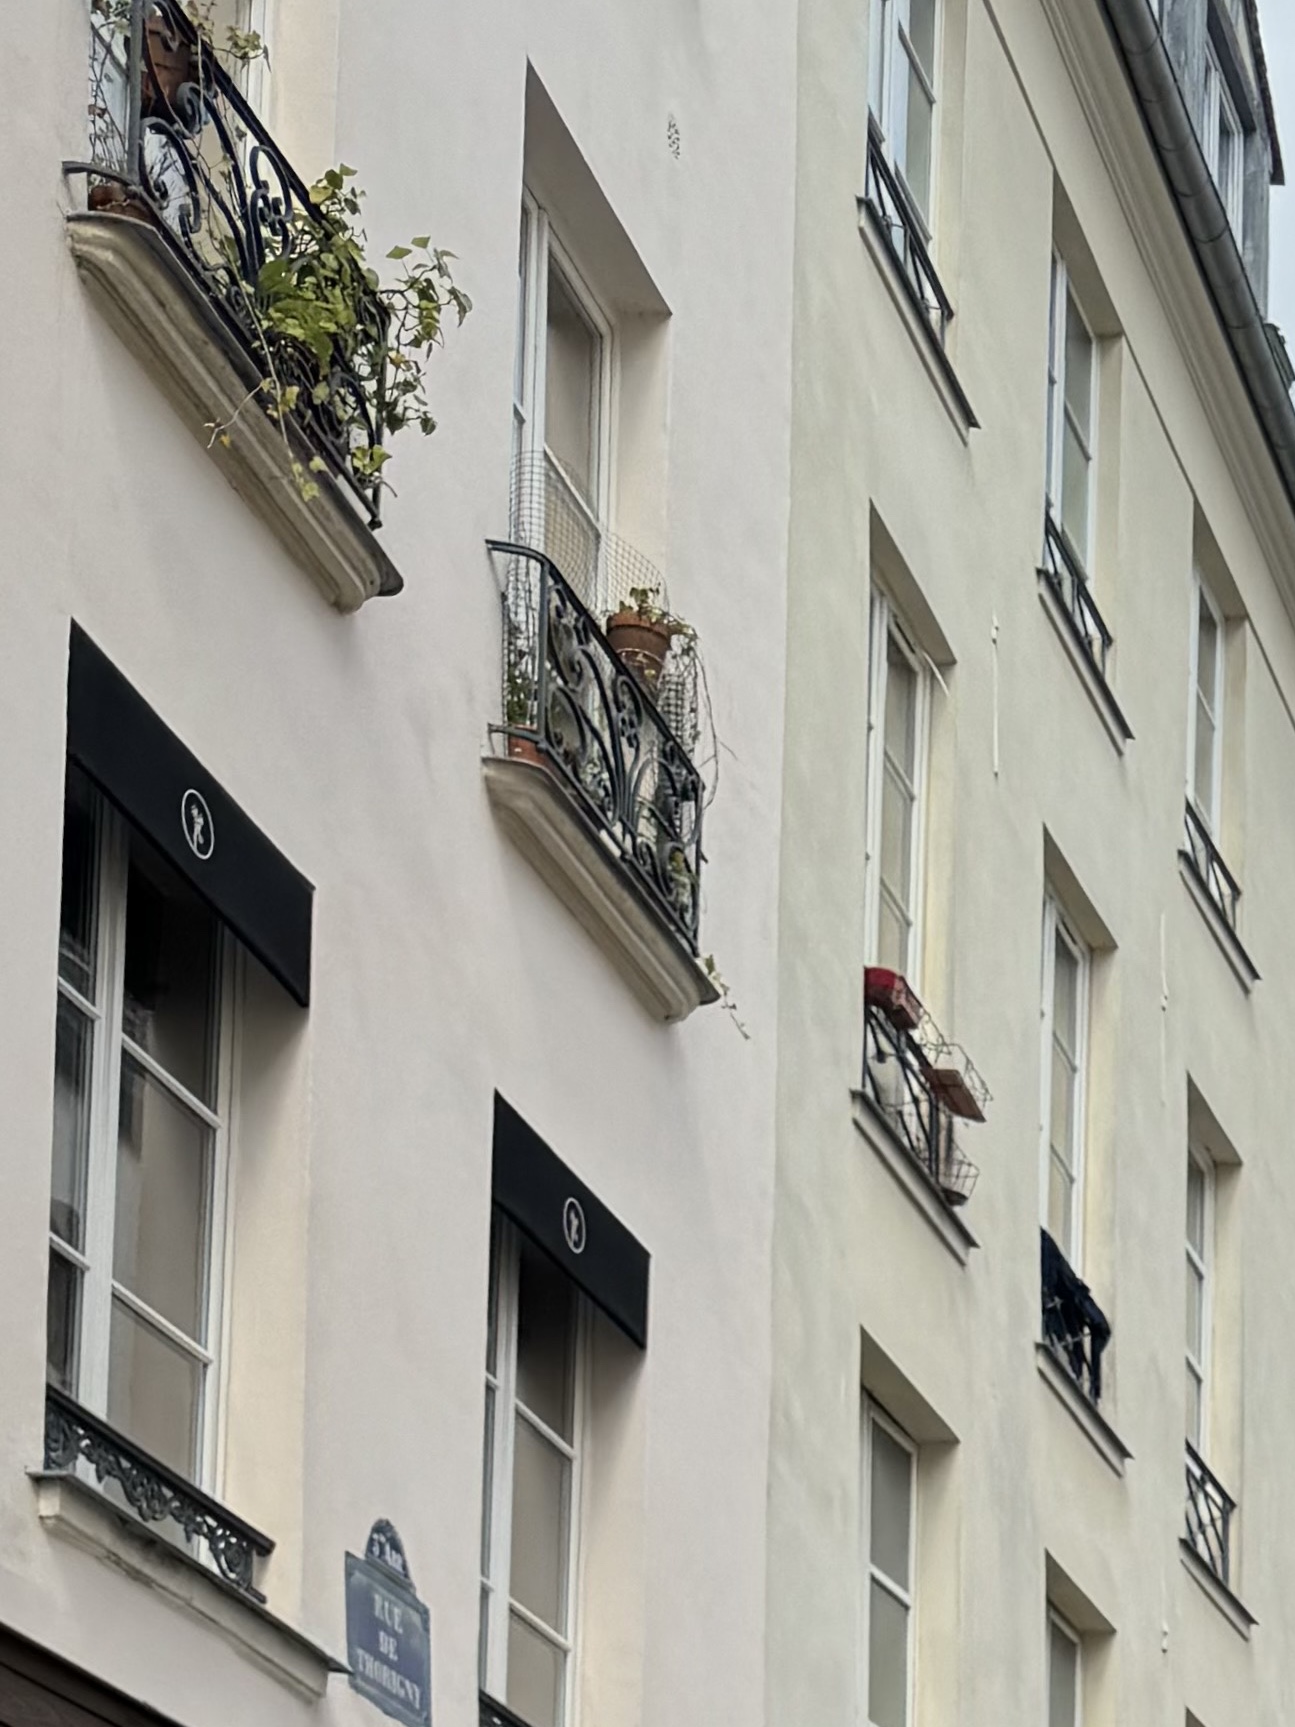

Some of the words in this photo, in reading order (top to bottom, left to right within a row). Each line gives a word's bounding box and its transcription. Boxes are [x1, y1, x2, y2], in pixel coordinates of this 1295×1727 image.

[374, 1593, 404, 1635] RUE
[378, 1630, 398, 1662] DE
[356, 1648, 422, 1710] THORIGNY
